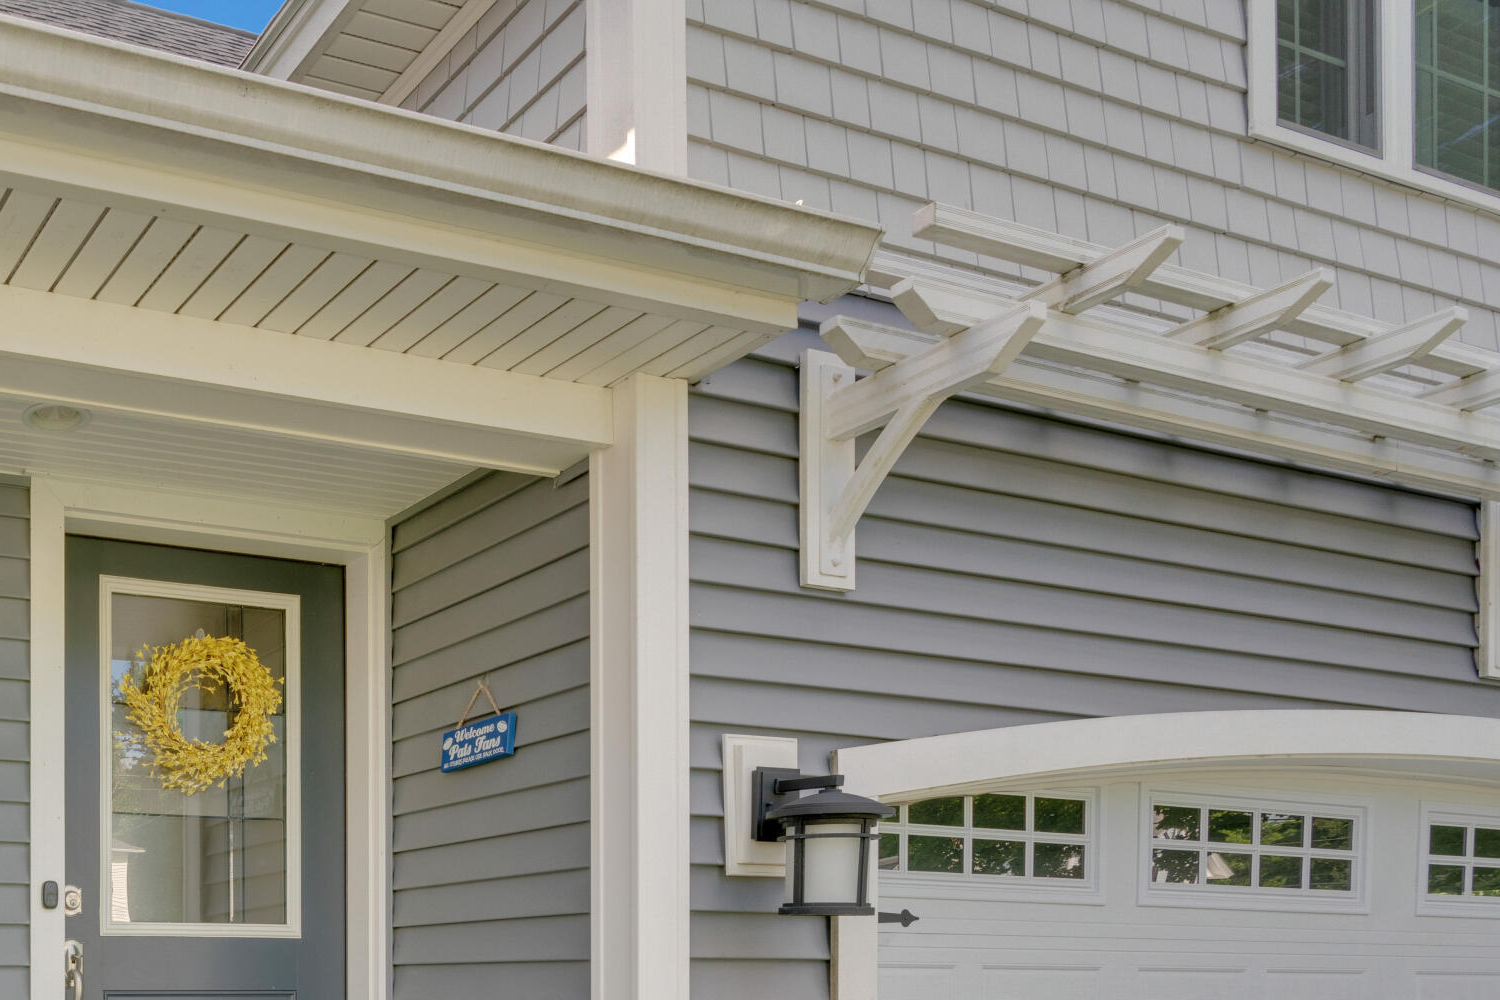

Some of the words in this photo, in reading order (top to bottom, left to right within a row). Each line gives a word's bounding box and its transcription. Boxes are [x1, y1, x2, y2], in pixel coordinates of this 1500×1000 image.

[455, 724, 495, 742] Welcome
[448, 743, 472, 761] Pats
[474, 735, 501, 753] Fans
